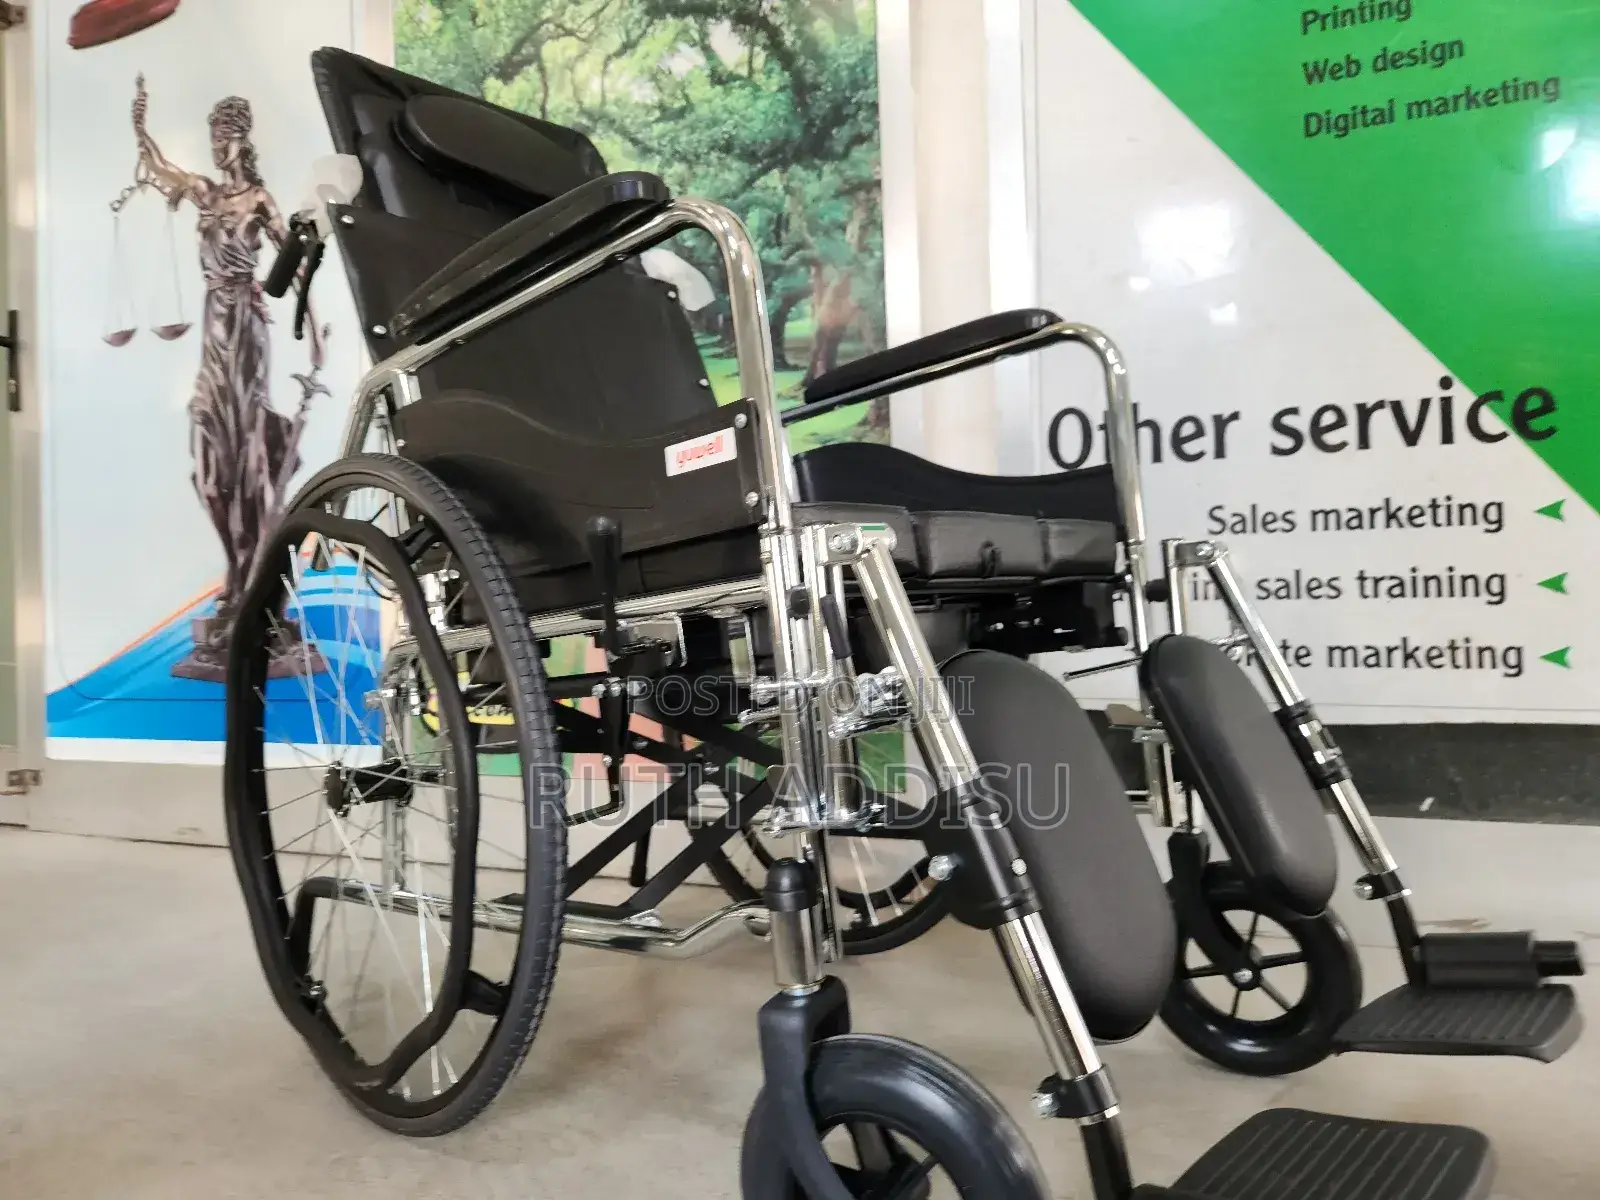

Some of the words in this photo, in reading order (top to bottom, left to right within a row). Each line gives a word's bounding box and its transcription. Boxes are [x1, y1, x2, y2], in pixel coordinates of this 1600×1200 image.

[1300, 0, 1412, 36] Printing
[1302, 53, 1362, 86] Web
[1371, 38, 1465, 74] design
[1304, 98, 1396, 139] Digital
[1405, 75, 1561, 119] marketing
[1269, 375, 1559, 457] service
[1207, 502, 1298, 536] Sales
[1309, 494, 1505, 534] marketing
[1256, 568, 1342, 601] sales
[1355, 566, 1507, 606] training
[1326, 637, 1525, 678] marketing
